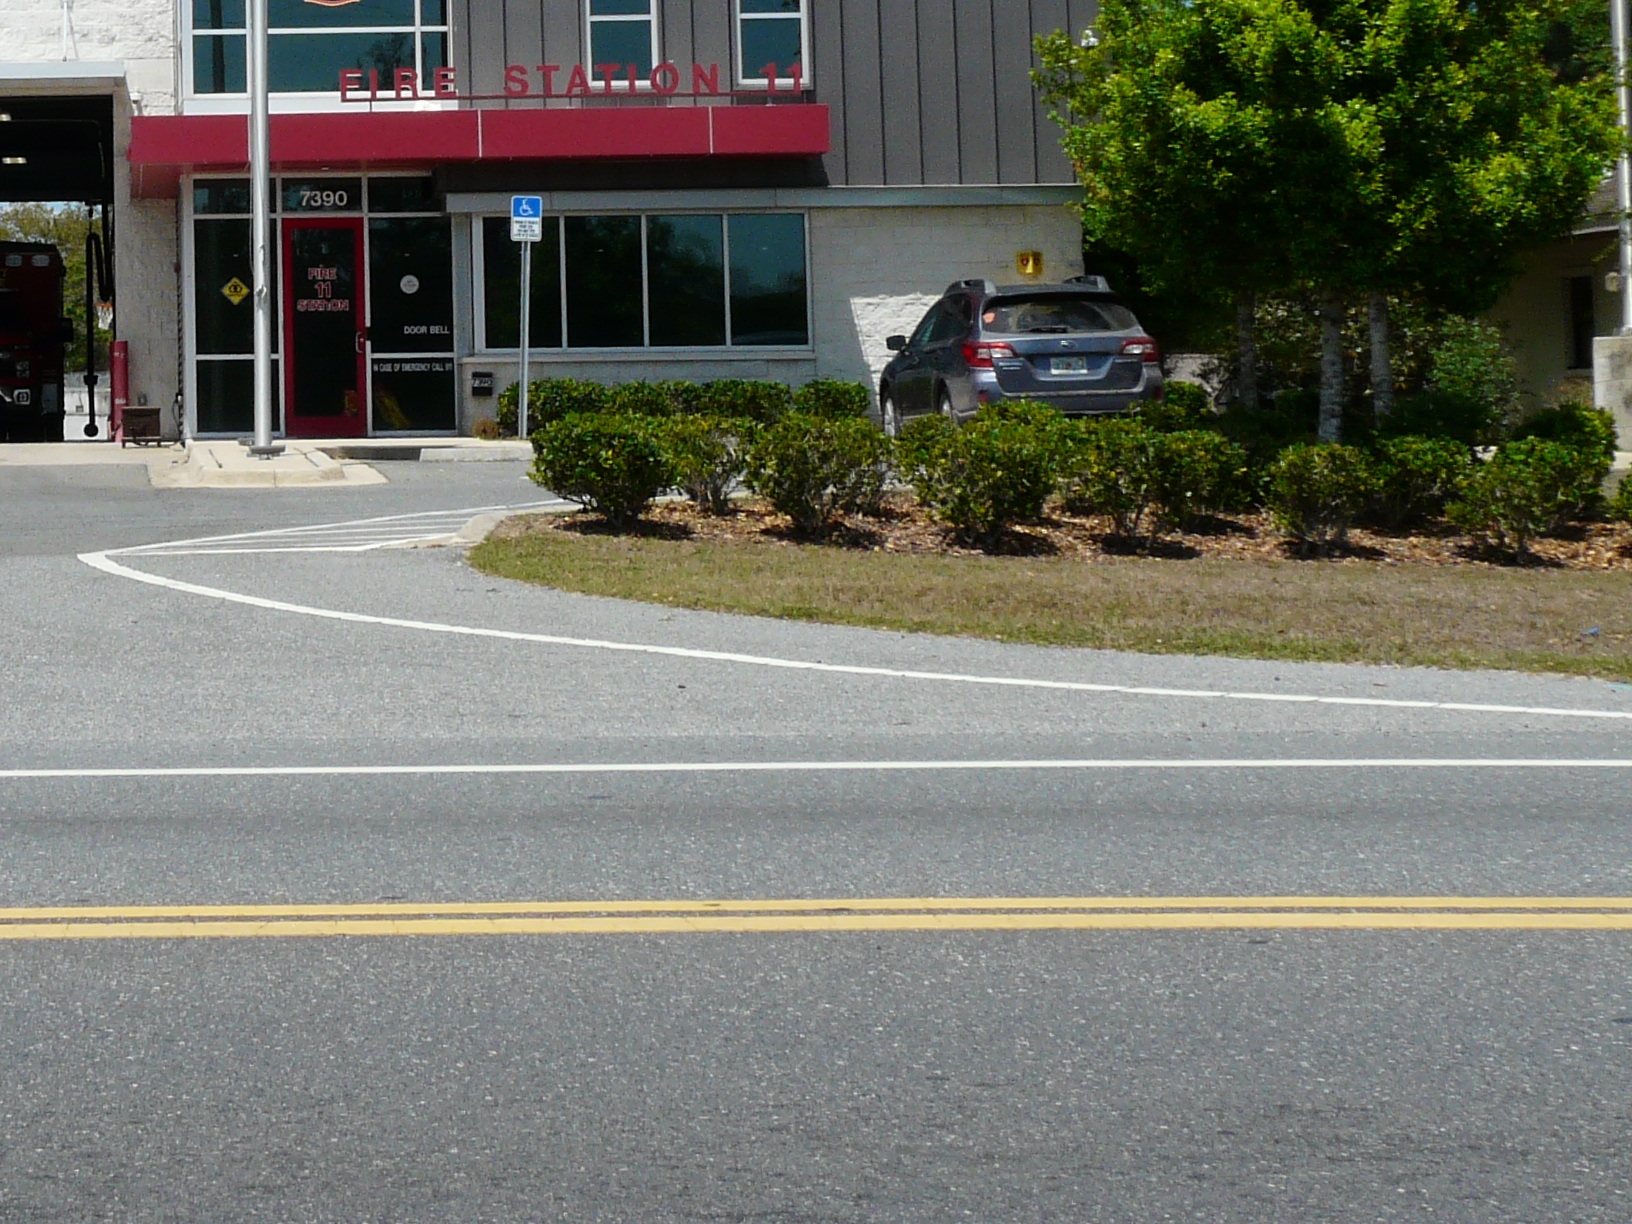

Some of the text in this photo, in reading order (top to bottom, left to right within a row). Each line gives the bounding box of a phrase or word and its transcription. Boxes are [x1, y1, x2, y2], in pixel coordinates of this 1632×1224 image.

[339, 62, 803, 100] FIRE STATION 11
[300, 190, 347, 207] 7390
[308, 267, 337, 280] FIRE
[314, 281, 332, 298] 11
[296, 299, 350, 312] STATION
[404, 325, 450, 335] DOOR BELL
